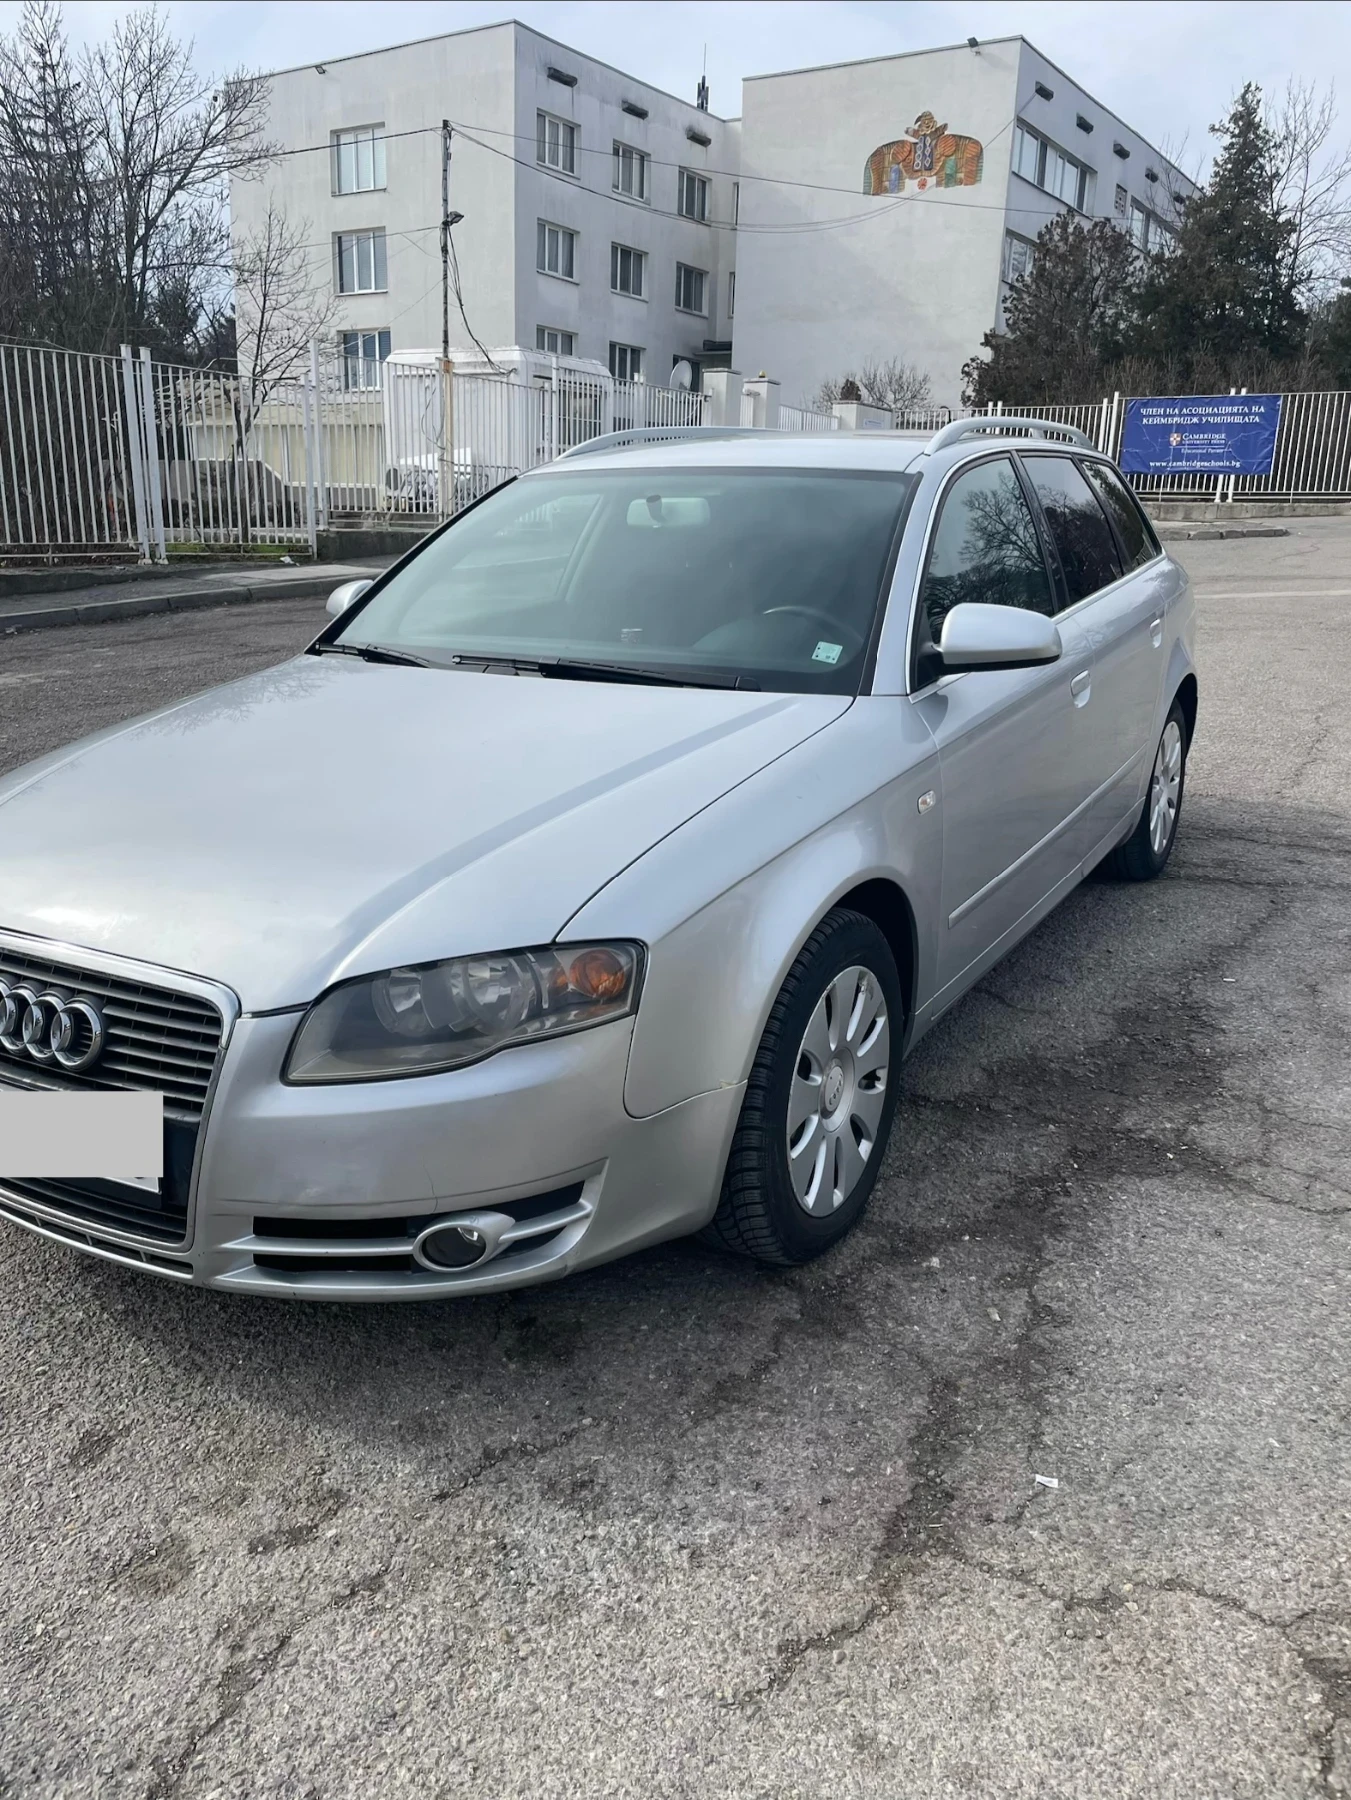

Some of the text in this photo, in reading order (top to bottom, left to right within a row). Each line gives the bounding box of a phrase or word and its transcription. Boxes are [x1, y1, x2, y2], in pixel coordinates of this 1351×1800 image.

[1181, 406, 1249, 415] АСОЦИАЦИЯТА
[1251, 405, 1265, 413] НА
[1142, 415, 1260, 425] КЕЙМБРИДЖ УЧИЛИЩАТА
[1182, 433, 1226, 441] CAMBRIDGE
[1149, 460, 1241, 468] www.cambridgeschools.bg
